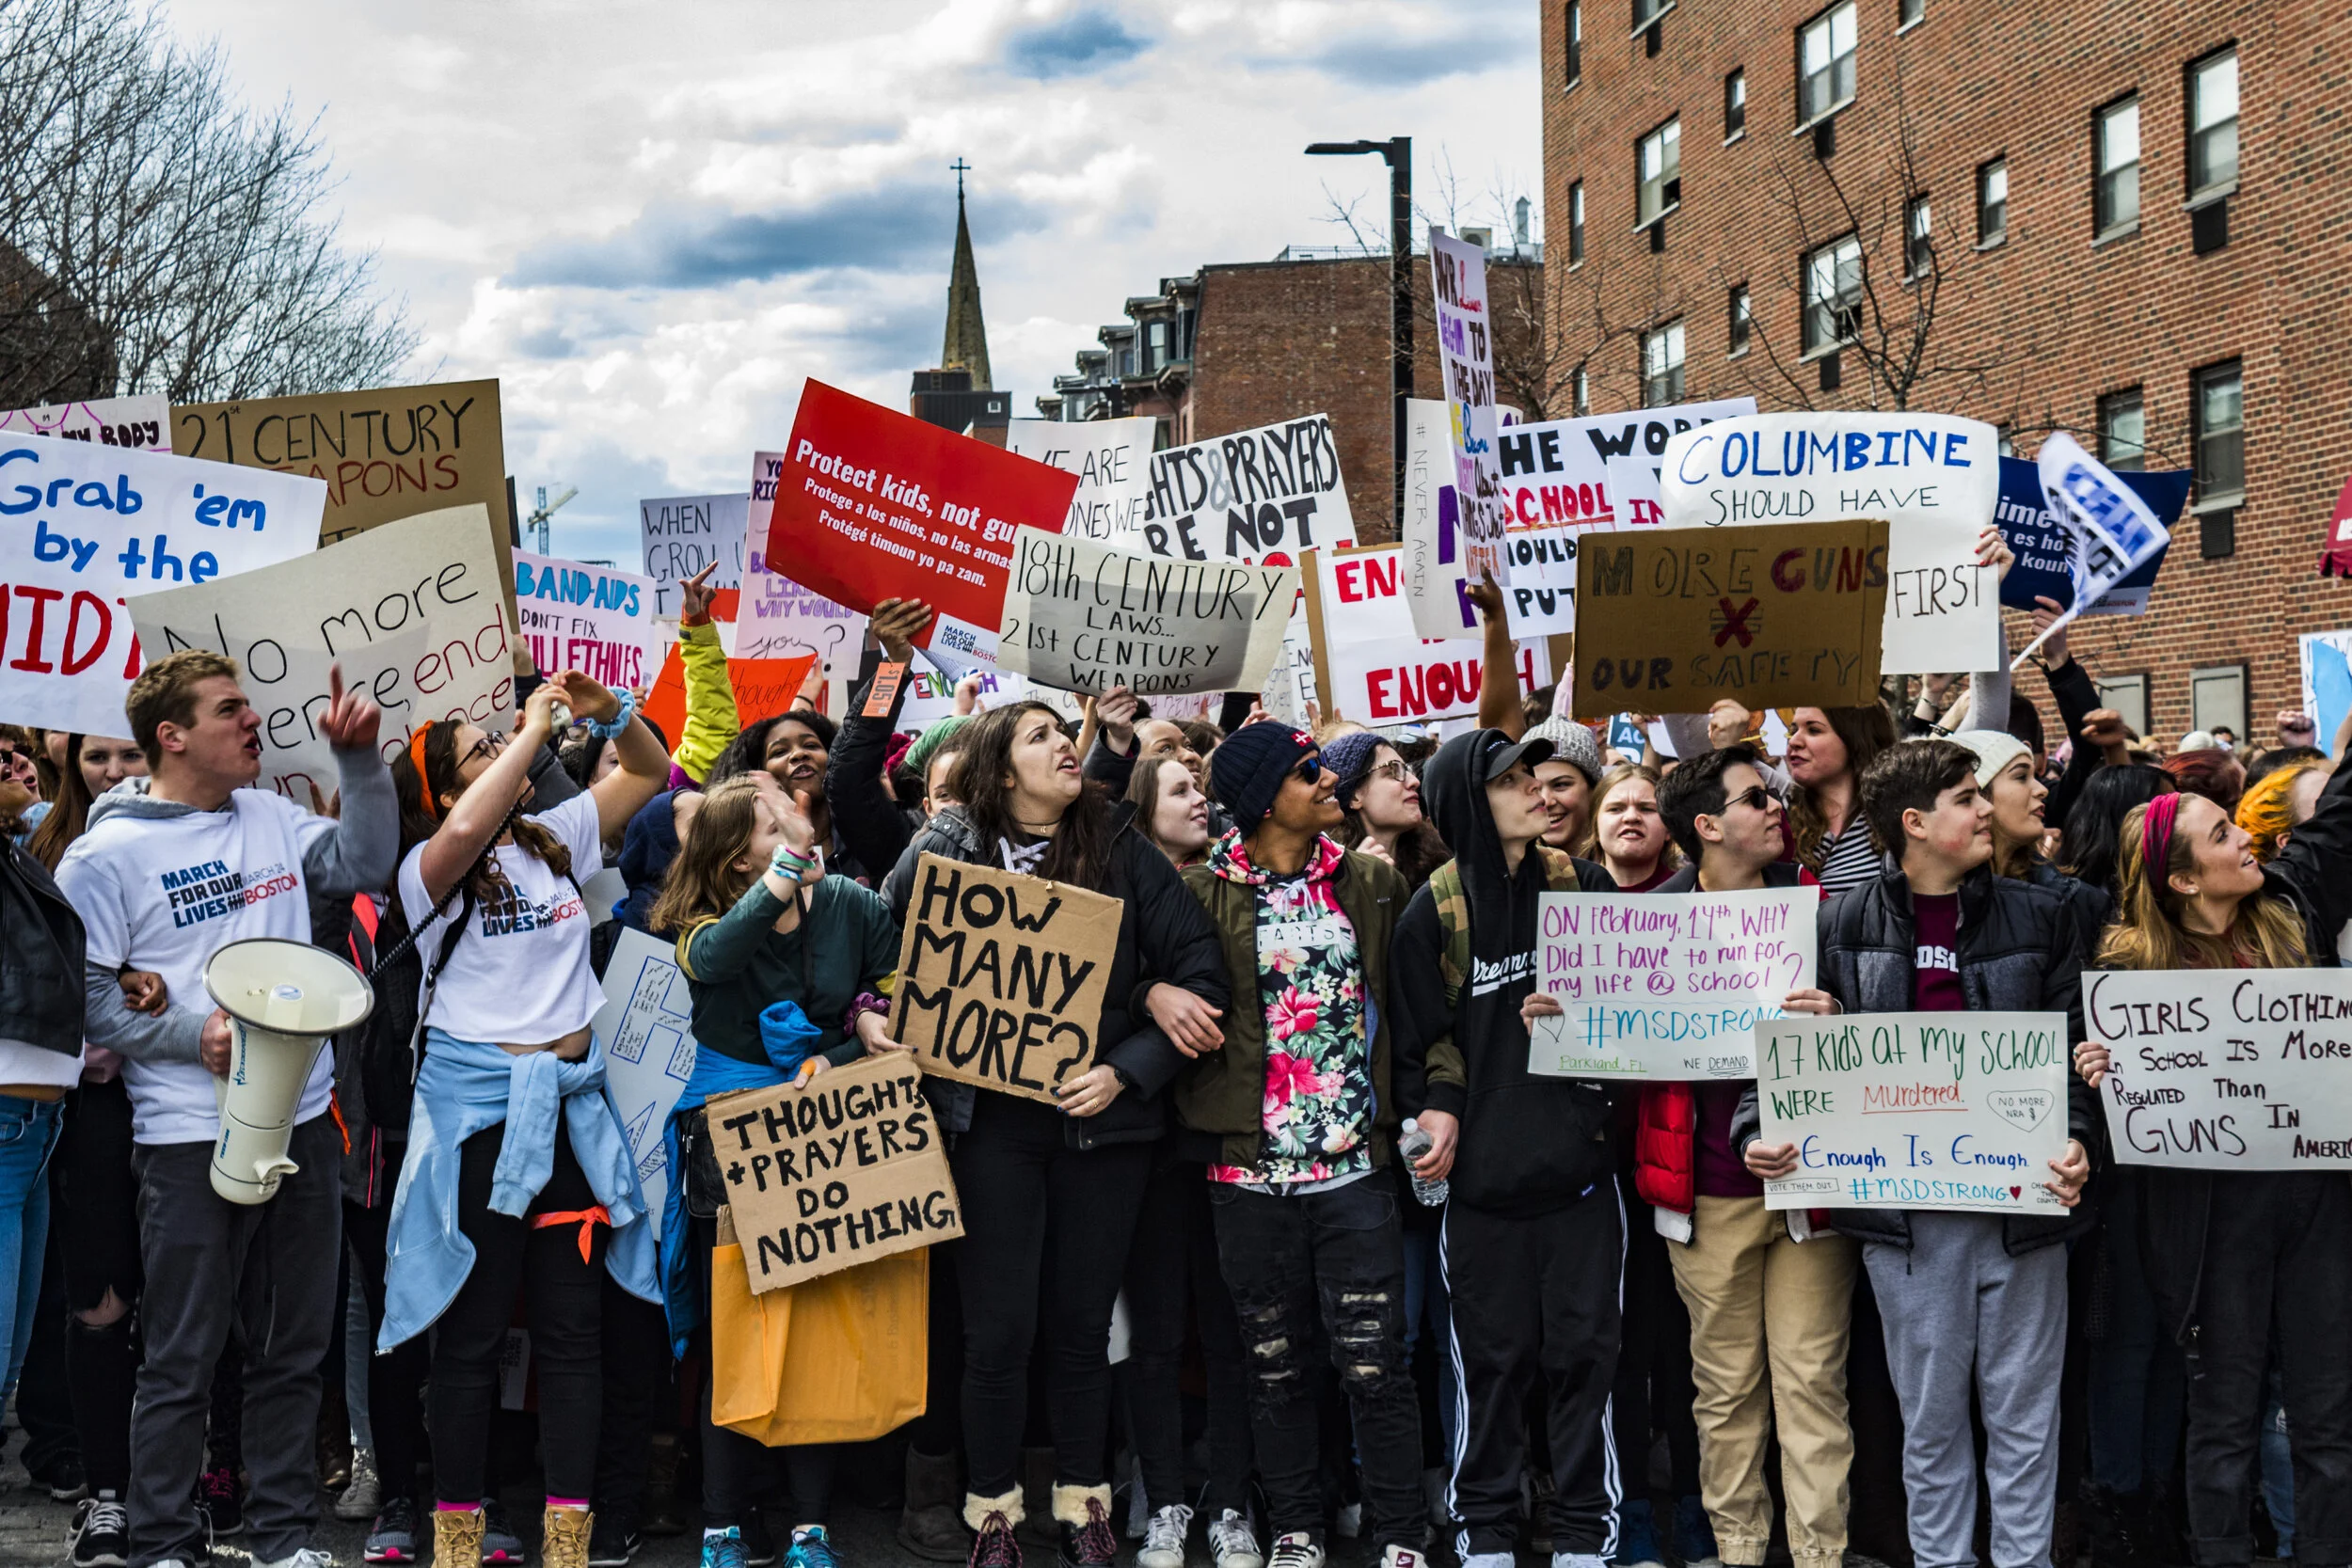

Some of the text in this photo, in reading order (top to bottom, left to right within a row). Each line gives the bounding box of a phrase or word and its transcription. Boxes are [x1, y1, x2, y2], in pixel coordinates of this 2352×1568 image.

[1469, 321, 1486, 362] TO
[1451, 358, 1492, 407] THE DAY
[101, 420, 160, 448] BODY
[254, 397, 474, 465] CENTURY
[1079, 445, 1130, 488] ARE
[1207, 419, 1339, 512] & PRAYERS
[1678, 428, 1972, 485] COLUMBINE
[0, 449, 266, 531] Grab 'em
[795, 438, 877, 494] Protect
[881, 479, 933, 518] kids,
[940, 500, 981, 531] not
[1413, 450, 1428, 525] NEVER
[644, 502, 710, 535] WHEN
[804, 477, 854, 512] Protege
[855, 501, 864, 515] a
[866, 505, 886, 524] los
[889, 515, 927, 542] niños,
[930, 531, 948, 547] no
[951, 534, 971, 556] las
[1115, 498, 1144, 533] WE
[1705, 485, 1941, 527] SHOULD HAVE
[1226, 497, 1317, 558] NOT
[2013, 532, 2036, 547] es
[34, 520, 218, 584] by the
[818, 509, 987, 588] Protégé timoun yo pa zam.
[1412, 539, 1428, 598] AGAIN
[516, 562, 641, 617] BAND-AIDS
[1017, 535, 1080, 601] 18th
[1094, 551, 1283, 622] CENTURY
[1592, 545, 1889, 599] MORE GUNS
[1894, 563, 1993, 619] FIRST
[320, 562, 478, 657] more
[571, 618, 597, 639] FIX
[755, 599, 795, 618] WHY
[414, 603, 509, 694] end
[941, 639, 961, 651] LIVES
[943, 631, 975, 648] FOR OUR
[945, 625, 977, 641] MARCH
[1002, 618, 1220, 668] 21st CENTURY
[872, 669, 900, 702] $1.05
[1070, 662, 1195, 692] WEAPONS
[1592, 647, 1859, 692] OUR SAFETY
[161, 860, 230, 891] MARCH
[167, 872, 298, 909] FOR OUR BOSTON
[173, 897, 229, 928] LIVES
[918, 865, 1062, 933] HOW
[483, 914, 535, 938] LIVES
[1543, 904, 1581, 939] ON
[1740, 903, 1790, 937] WHY
[904, 925, 1097, 1015] MANY
[1546, 940, 1786, 974] Did I have to run for
[1548, 976, 1583, 998] my
[1596, 973, 1633, 995] life
[1646, 972, 1676, 996] @
[2090, 974, 2210, 1040] GIRLS
[894, 980, 1089, 1098] MORE?
[1767, 1035, 1805, 1081] 17
[2226, 1038, 2259, 1062] IS
[1629, 1056, 1646, 1070] FL
[1683, 1055, 1750, 1069] WE DEMAND
[1771, 1089, 1835, 1121] WERE
[1997, 1097, 2045, 1107] NO MORE
[2214, 1078, 2266, 1100] Than
[2006, 1110, 2025, 1119] NRA
[2126, 1106, 2247, 1156] GUNS
[1802, 1134, 1886, 1173] Enough
[1902, 1134, 1933, 1166] Is
[796, 1180, 850, 1218] DO
[1769, 1181, 1833, 1192] VOTE THEM OUT
[756, 1190, 957, 1275] NOTHING
